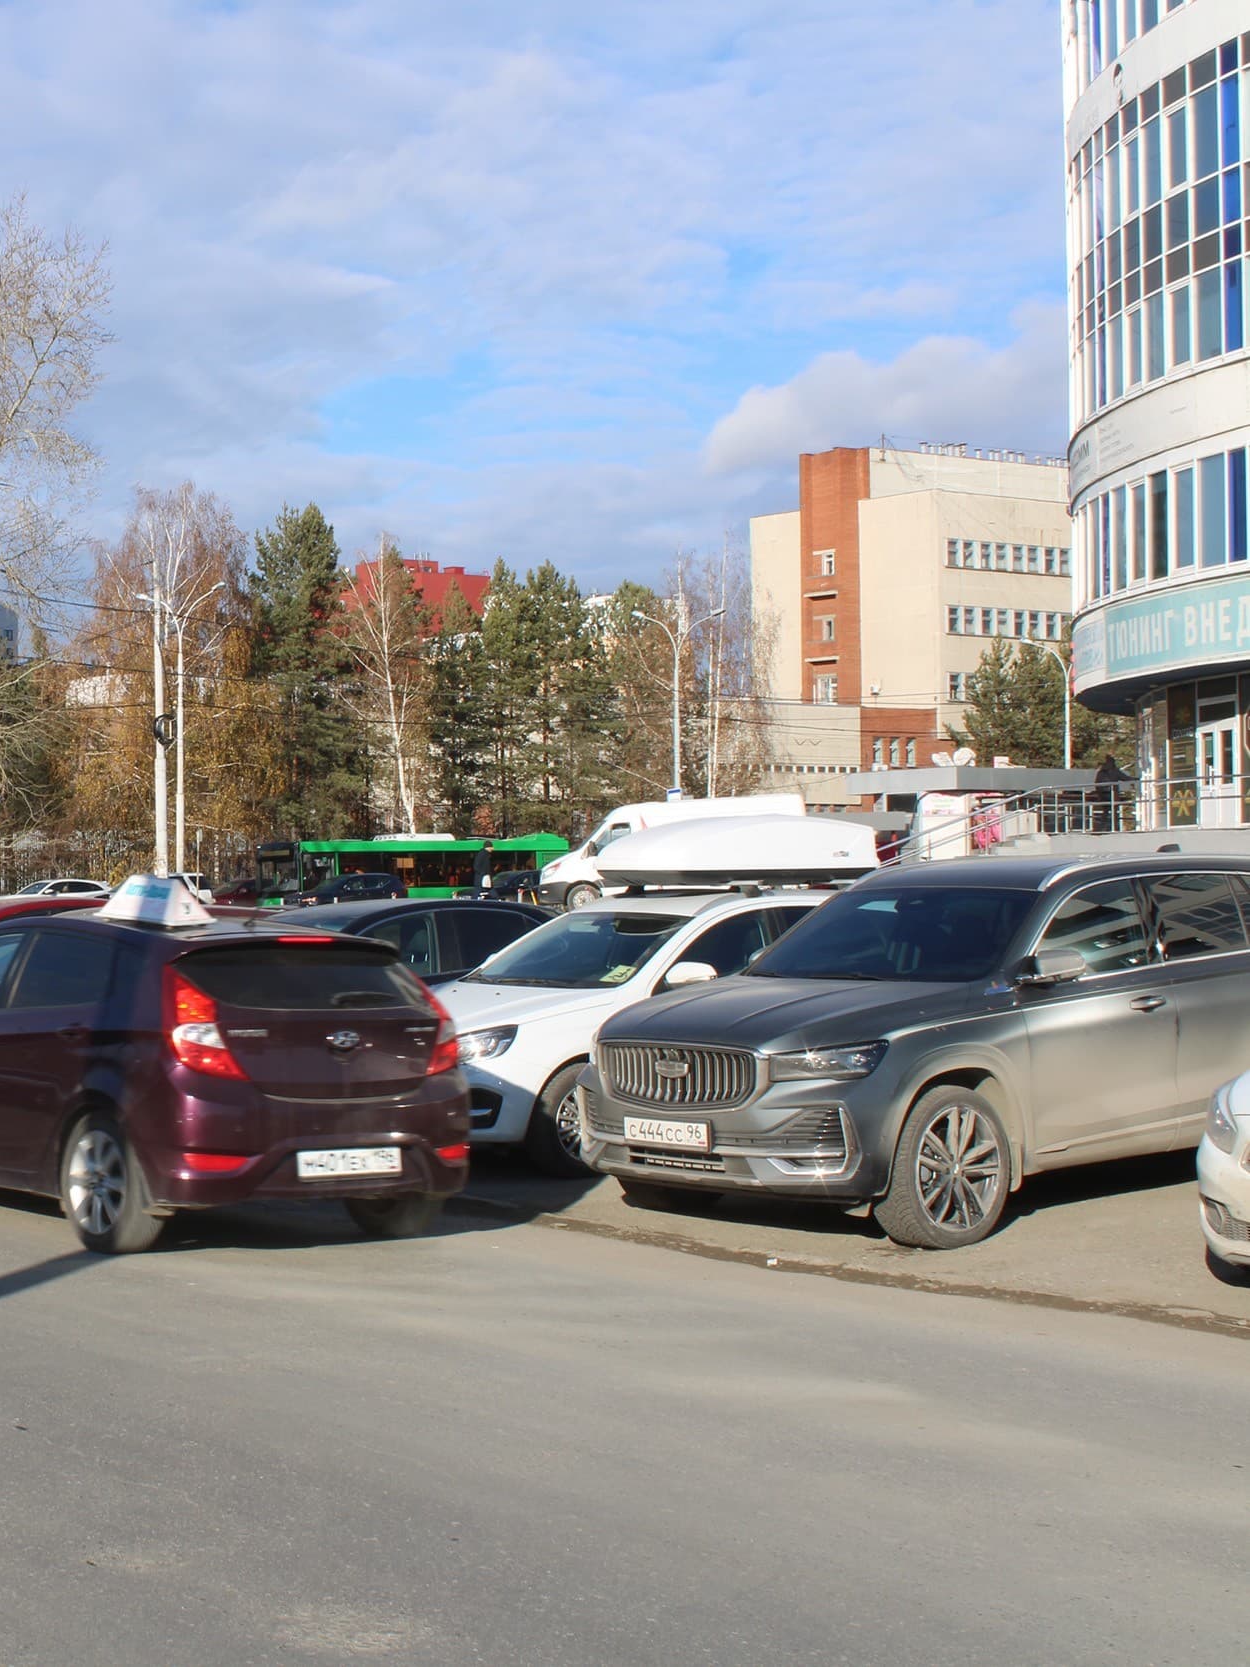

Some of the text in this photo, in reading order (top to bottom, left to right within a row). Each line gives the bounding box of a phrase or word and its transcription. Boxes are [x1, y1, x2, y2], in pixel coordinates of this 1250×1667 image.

[1108, 610, 1174, 662] ТЮНИНГ
[630, 1121, 702, 1142] С444СС 96
